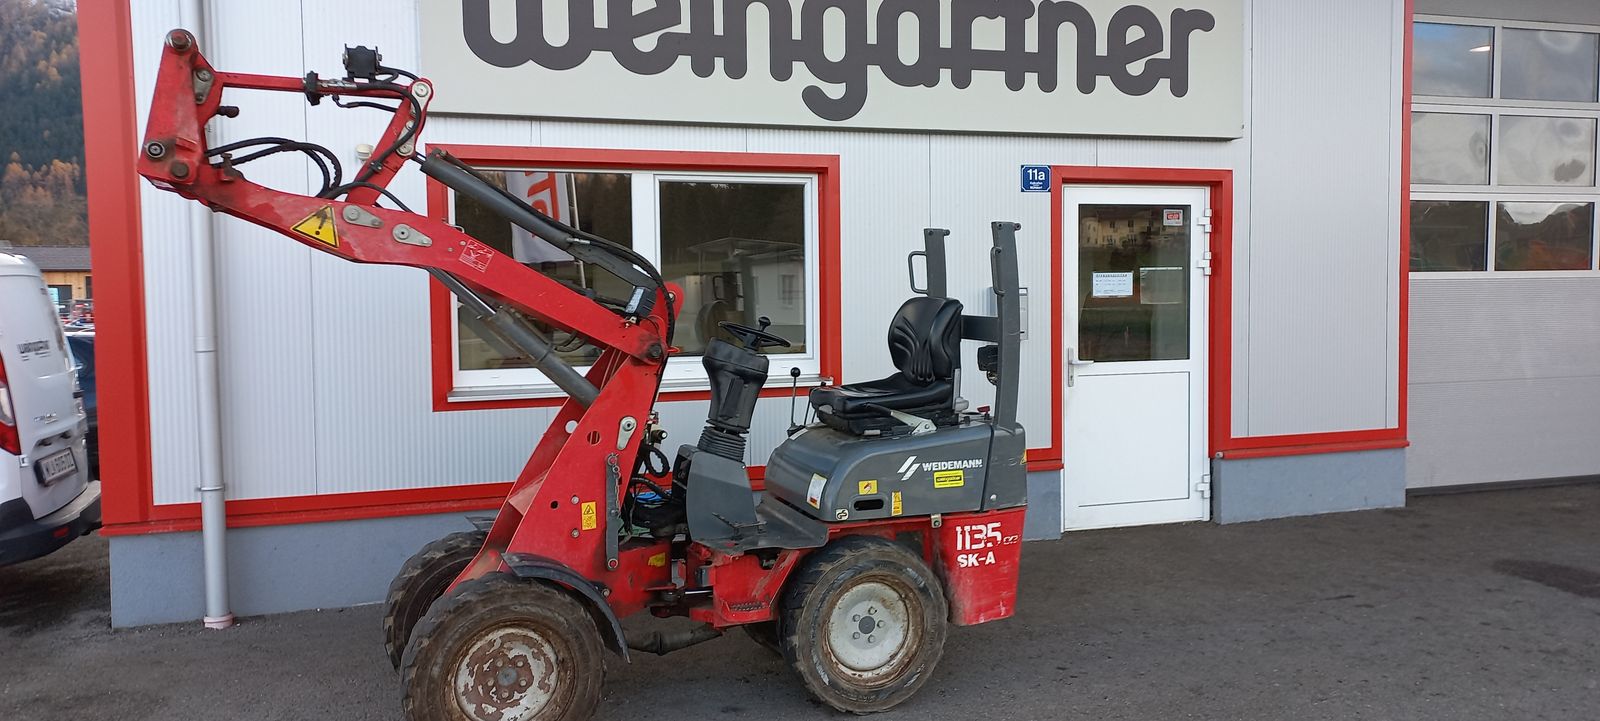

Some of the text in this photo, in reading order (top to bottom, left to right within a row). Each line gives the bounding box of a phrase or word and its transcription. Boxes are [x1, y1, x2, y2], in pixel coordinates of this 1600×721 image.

[1026, 168, 1046, 181] 11a
[922, 459, 984, 472] WEIDEMANN
[955, 521, 1002, 551] 1135
[956, 551, 996, 568] SK-A
